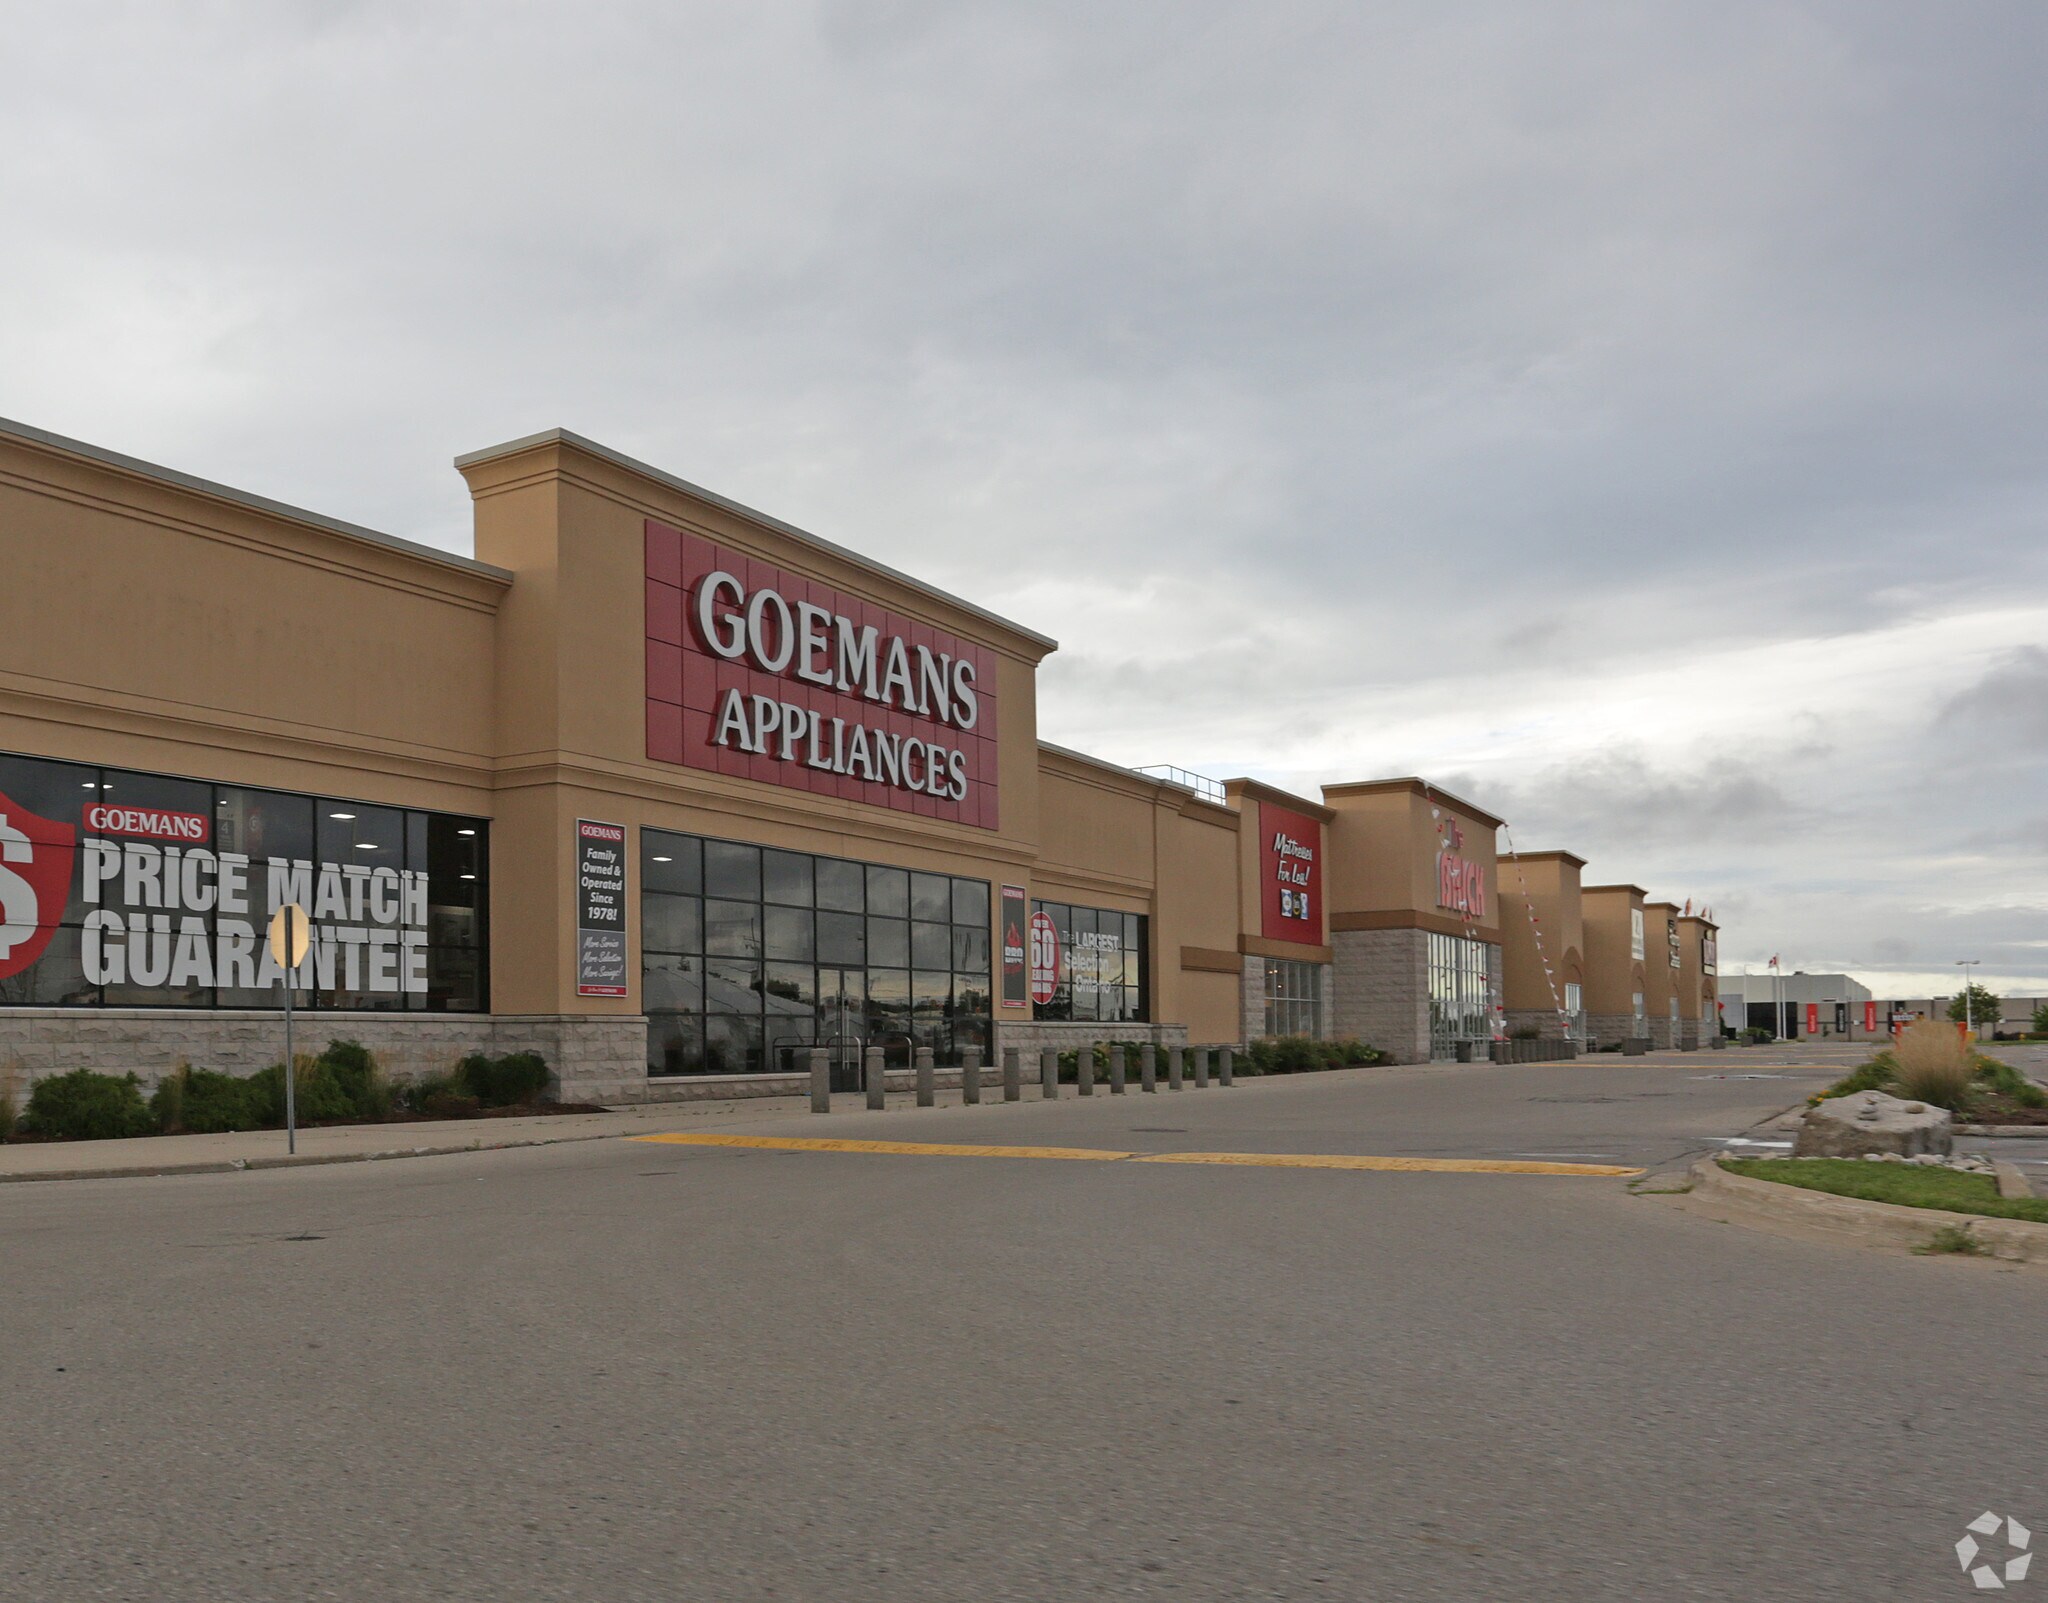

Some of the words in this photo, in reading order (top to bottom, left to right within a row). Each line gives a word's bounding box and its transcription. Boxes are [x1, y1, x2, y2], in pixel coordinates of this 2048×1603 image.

[698, 570, 979, 730] GOEMANS
[714, 688, 969, 802] APPLIANCES
[89, 807, 203, 839] GOEMANS
[581, 825, 622, 840] GOEMANS
[586, 847, 617, 864] Family
[582, 862, 613, 876] Owned
[613, 865, 622, 877] &
[1277, 860, 1291, 882] For
[82, 838, 249, 913] PRICE
[267, 856, 429, 925] MATCH
[581, 876, 623, 891] Operated
[1436, 851, 1486, 916] BRICK
[590, 891, 614, 905] Since
[588, 906, 618, 921] 1978!
[81, 909, 429, 993] GUARANTEE
[1030, 928, 1055, 970] 60
[1075, 931, 1119, 952] LARGEST
[1064, 950, 1109, 973] Selection
